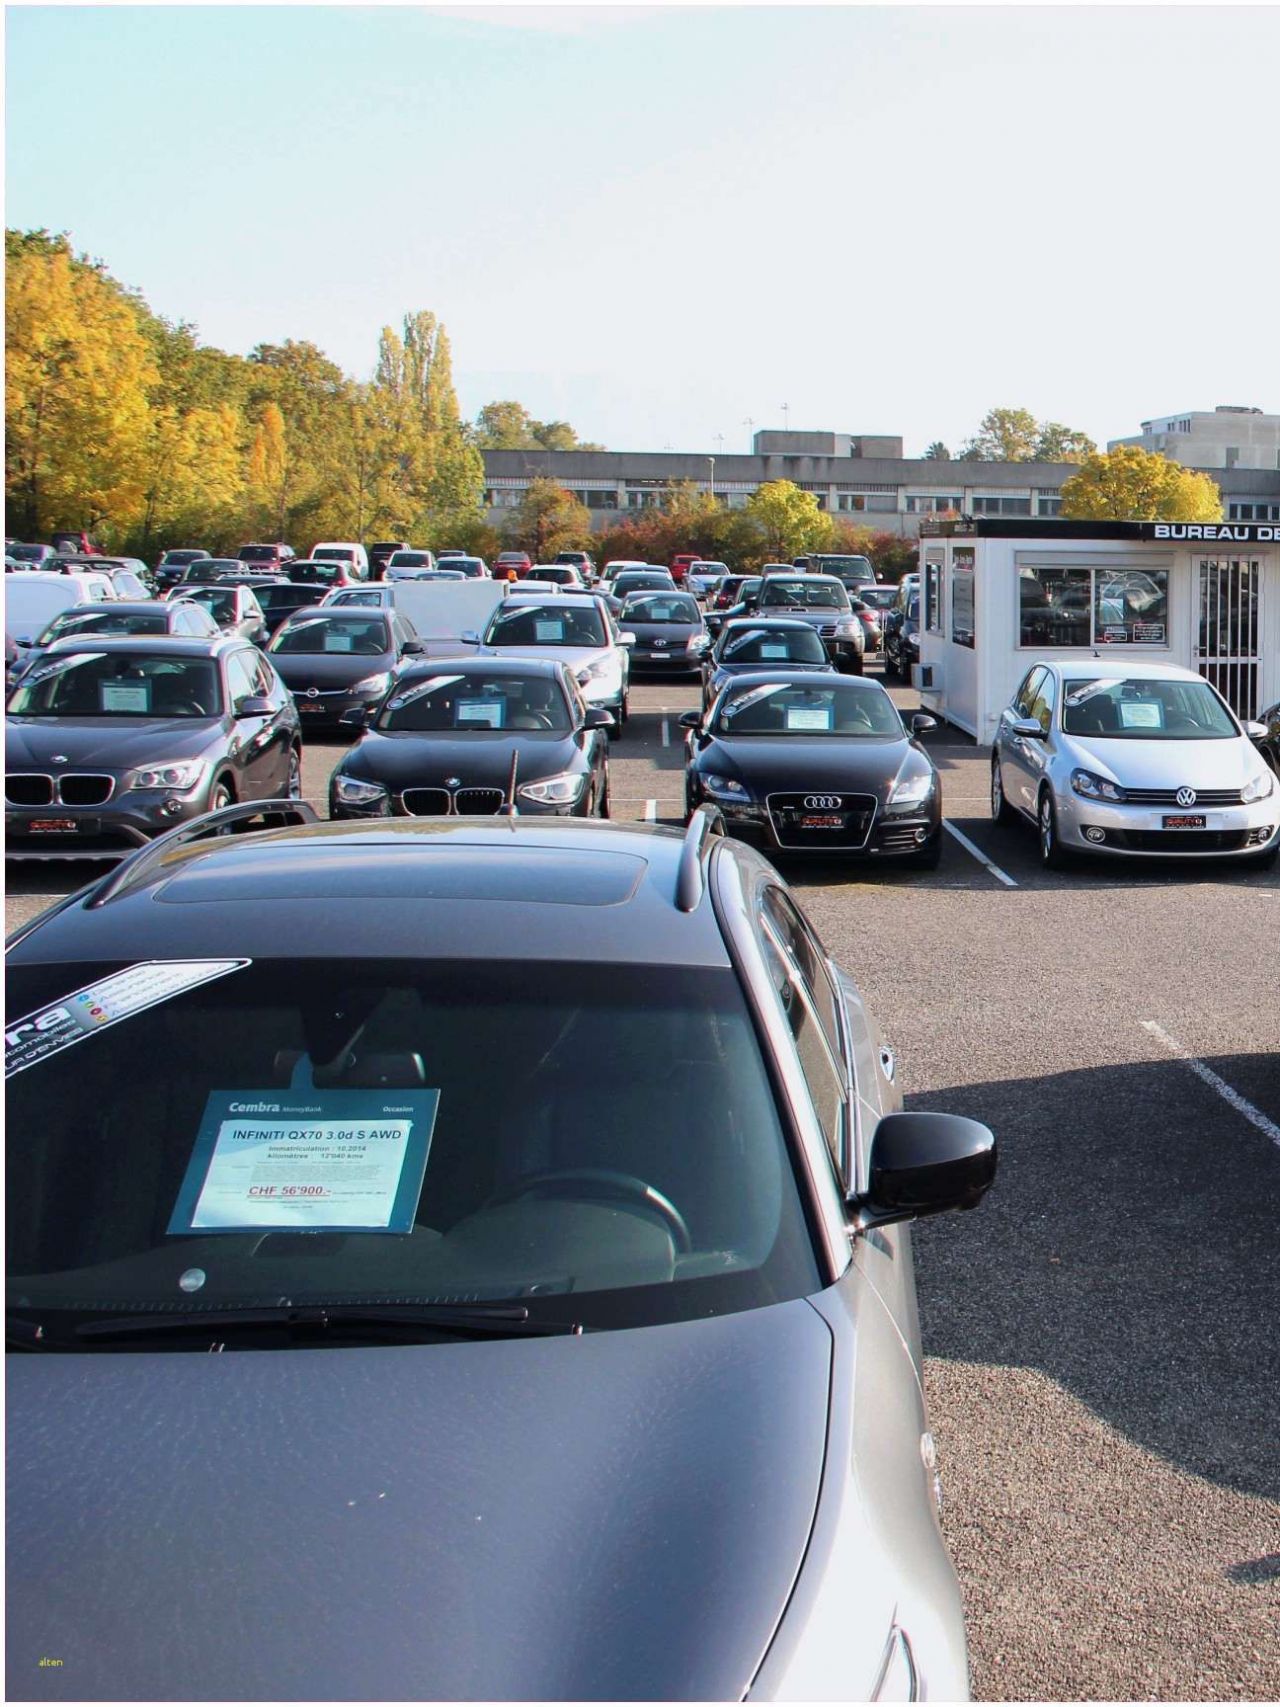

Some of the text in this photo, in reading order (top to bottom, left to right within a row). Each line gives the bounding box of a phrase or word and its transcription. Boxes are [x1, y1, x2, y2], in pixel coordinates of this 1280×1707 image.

[1154, 525, 1249, 540] BUREAU
[229, 1101, 280, 1112] Cembra
[382, 1105, 414, 1113] Occasion
[232, 1130, 402, 1140] INFINITI QX70 3.0d S AWD
[249, 1186, 278, 1195] CHF
[280, 1185, 332, 1196] 56'900.-
